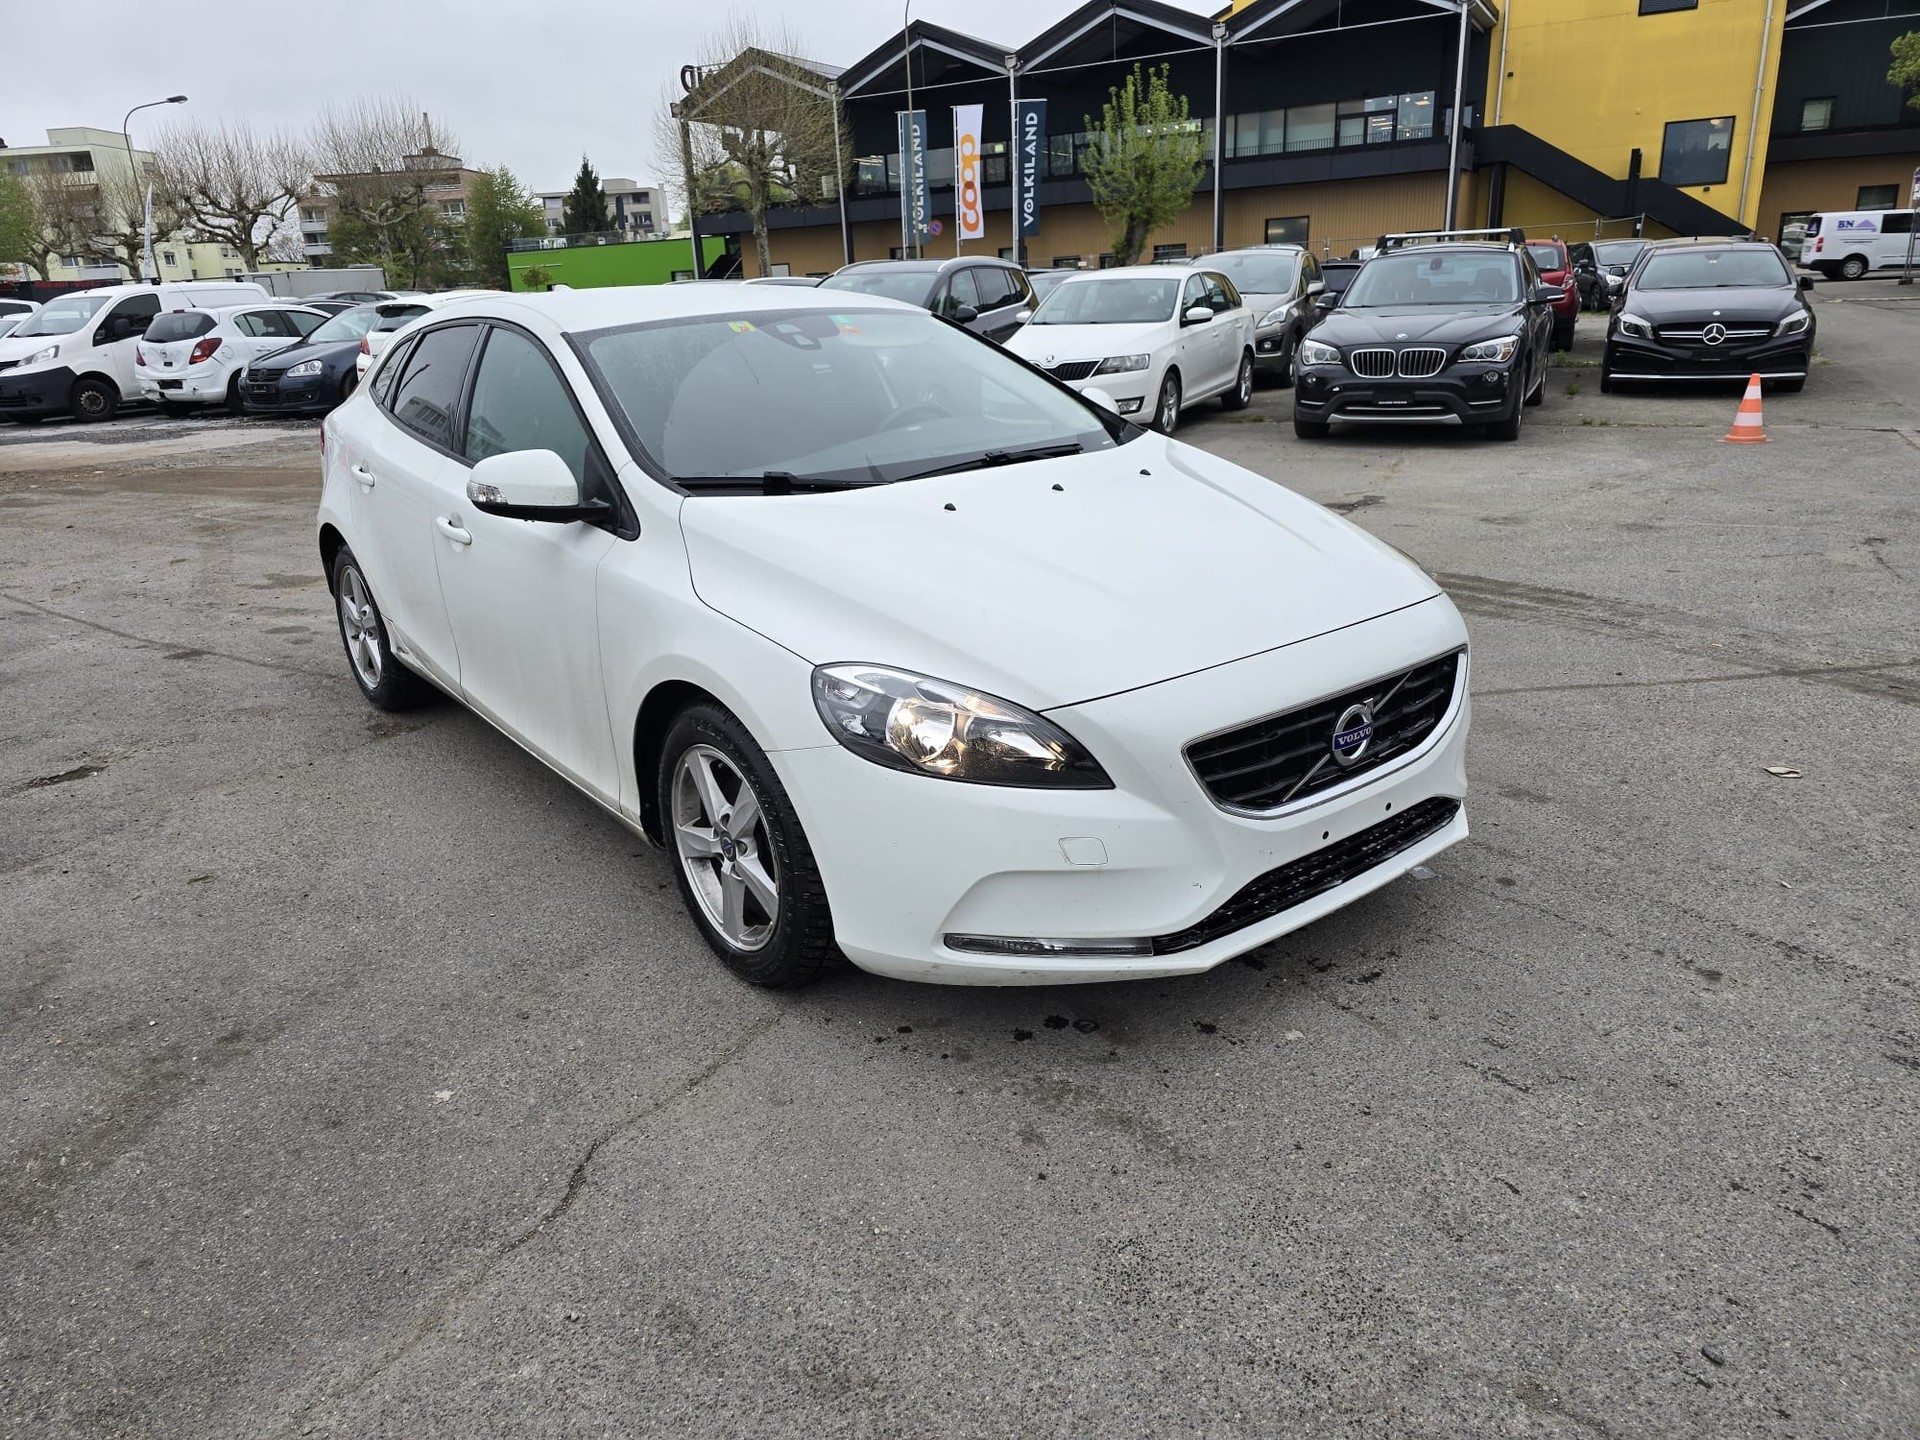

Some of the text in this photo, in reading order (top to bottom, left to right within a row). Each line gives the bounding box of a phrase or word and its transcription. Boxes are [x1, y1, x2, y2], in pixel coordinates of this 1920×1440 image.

[960, 133, 981, 232] coop
[1023, 112, 1038, 227] VOLKILAND
[1837, 220, 1855, 228] BN
[1337, 726, 1372, 746] VOLVO
